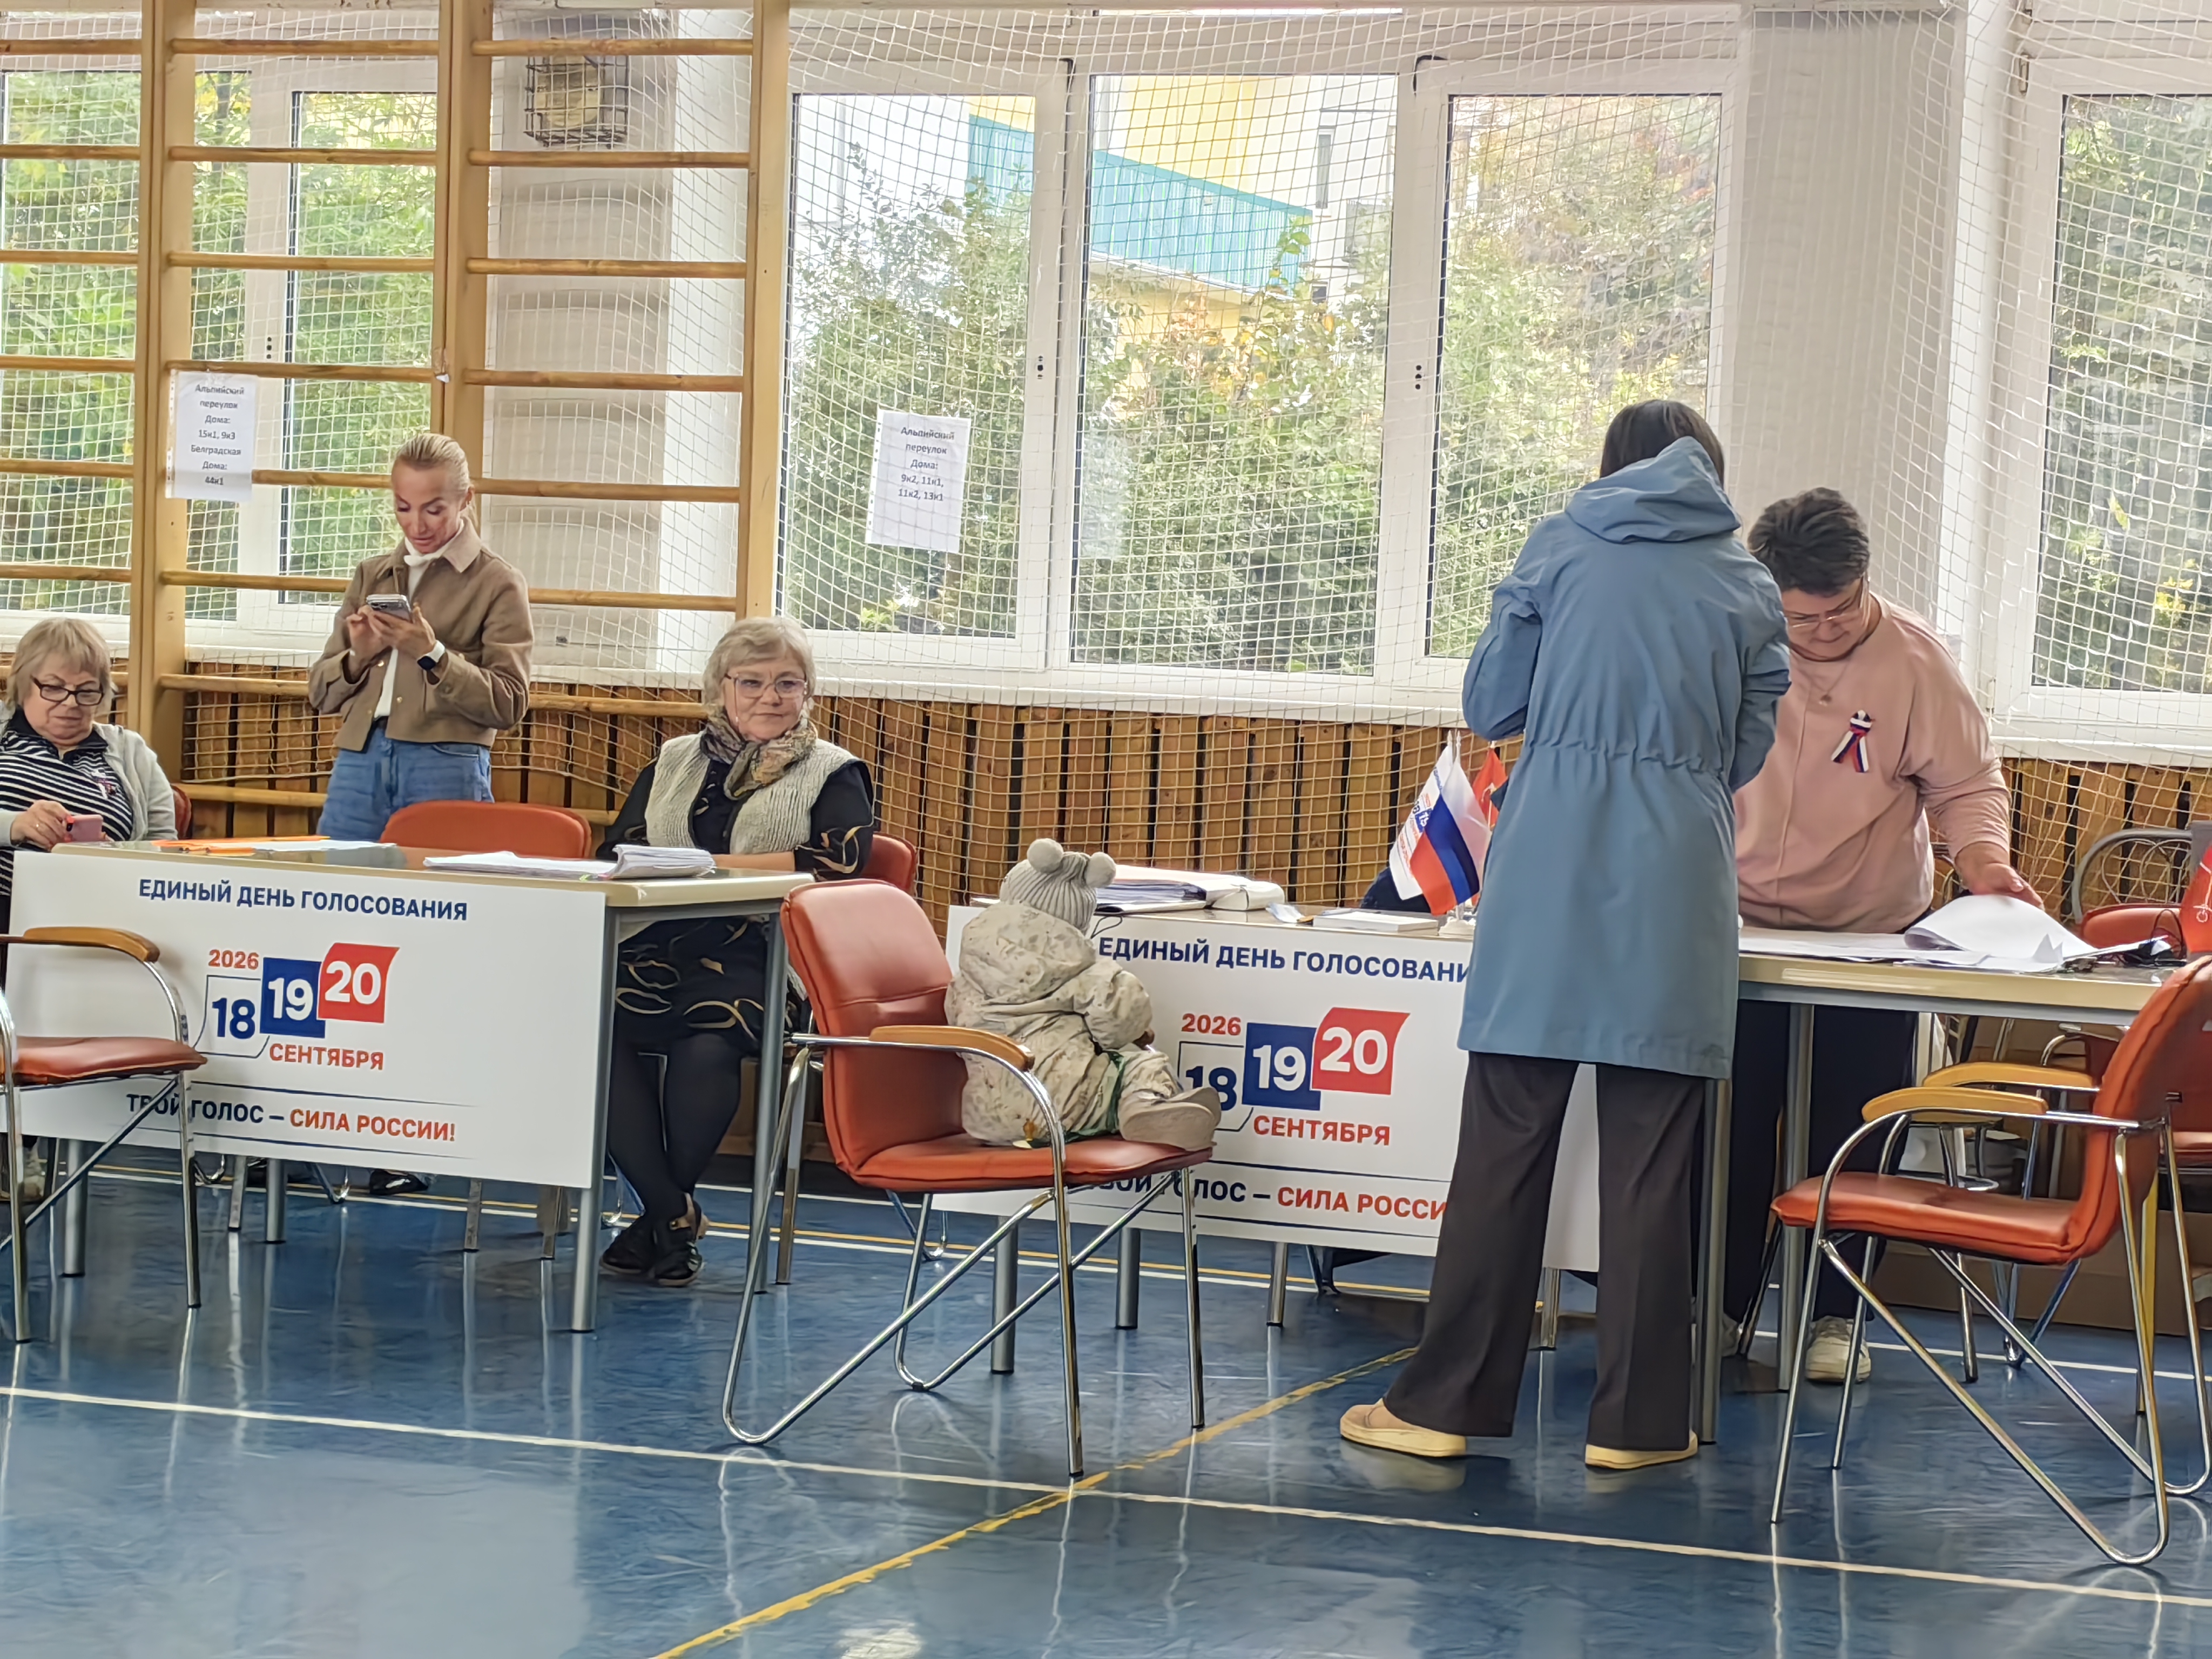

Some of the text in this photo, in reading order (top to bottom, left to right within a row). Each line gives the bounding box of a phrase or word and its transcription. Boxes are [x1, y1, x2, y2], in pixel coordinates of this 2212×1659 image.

[195, 384, 245, 395] Альпийский
[200, 401, 238, 409] переулок
[205, 415, 231, 424] Дома:
[900, 427, 955, 440] Альпийский
[191, 444, 241, 456] Белградская
[906, 444, 947, 455] переулок
[202, 461, 227, 470] Дома:
[910, 460, 938, 469] Дома:
[139, 879, 467, 921] ЕДИНЫЙ ДЕНЬ ГОЛОСОВАНИЯ
[208, 949, 259, 969] 2026
[1099, 937, 1469, 983] ЕДИНЫЙ ДЕНЬ ГОЛОСОВАНИ
[212, 961, 381, 1040] 18 19 20
[1181, 1013, 1241, 1036] 2026
[269, 1043, 384, 1070] СЕНТЯБРЯ
[1186, 1027, 1388, 1111] 18 19 20
[192, 1100, 264, 1123] ГОЛОС
[290, 1109, 350, 1132] СИЛА
[357, 1115, 455, 1141] РОССИИ!
[1253, 1115, 1391, 1145] СЕНТЯБРЯ
[1277, 1186, 1350, 1212] СИЛА
[1357, 1193, 1447, 1220] РОССИ
